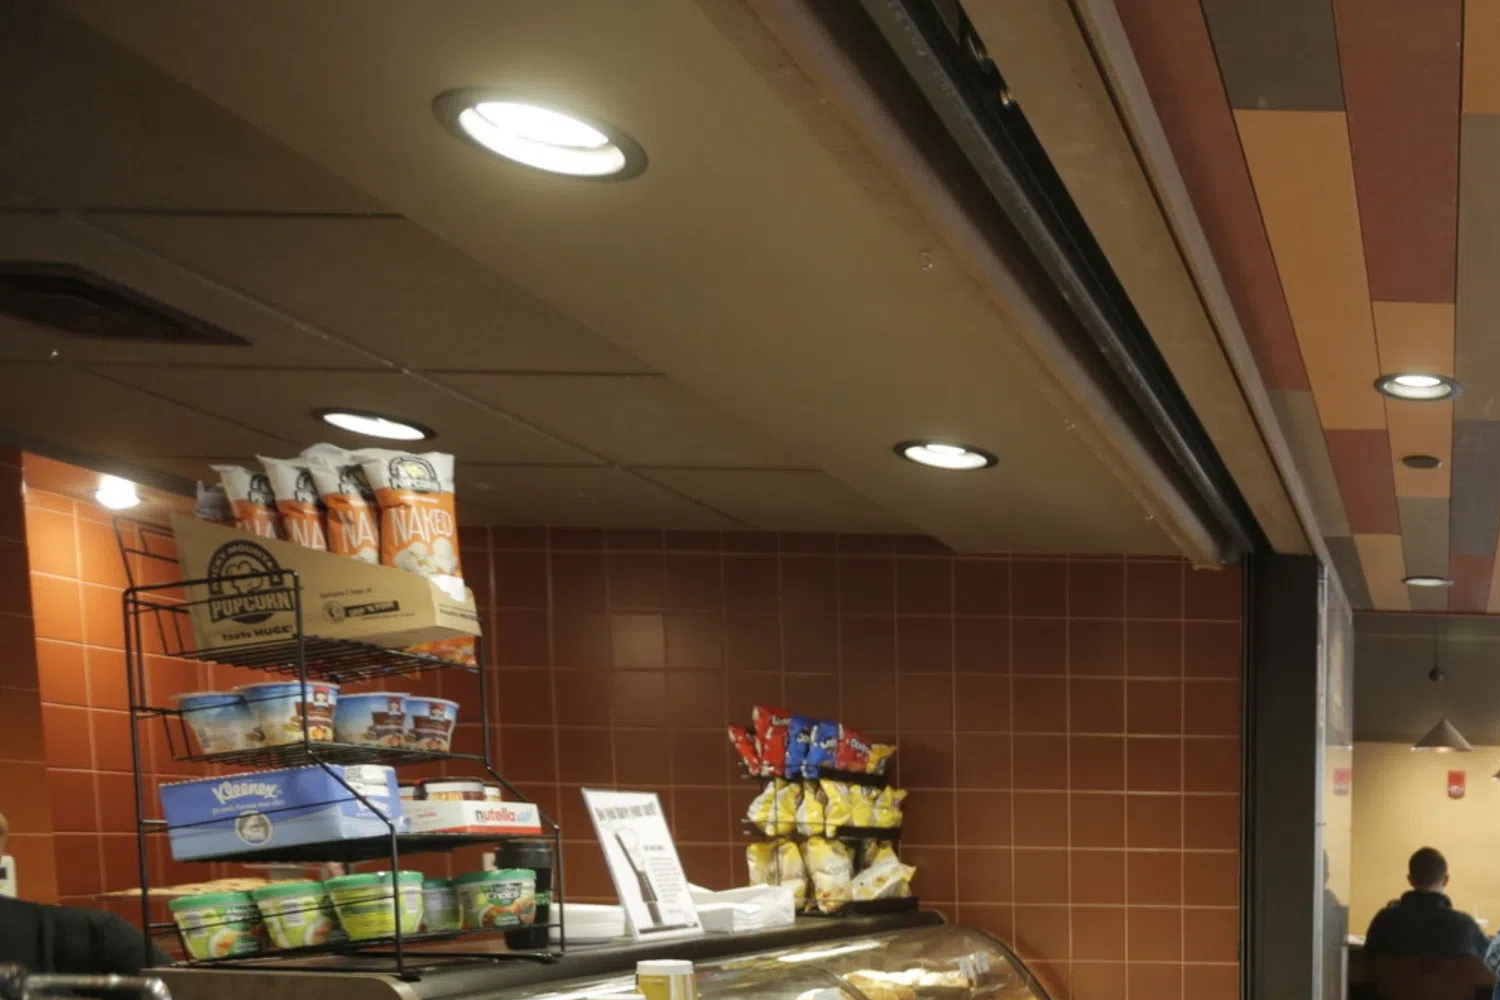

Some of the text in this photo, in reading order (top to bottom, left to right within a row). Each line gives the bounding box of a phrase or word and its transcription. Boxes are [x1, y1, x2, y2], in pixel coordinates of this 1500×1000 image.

[390, 506, 454, 547] NAKED
[211, 592, 295, 619] POPCORN
[212, 781, 279, 803] Kleenex
[475, 808, 515, 822] nutella
